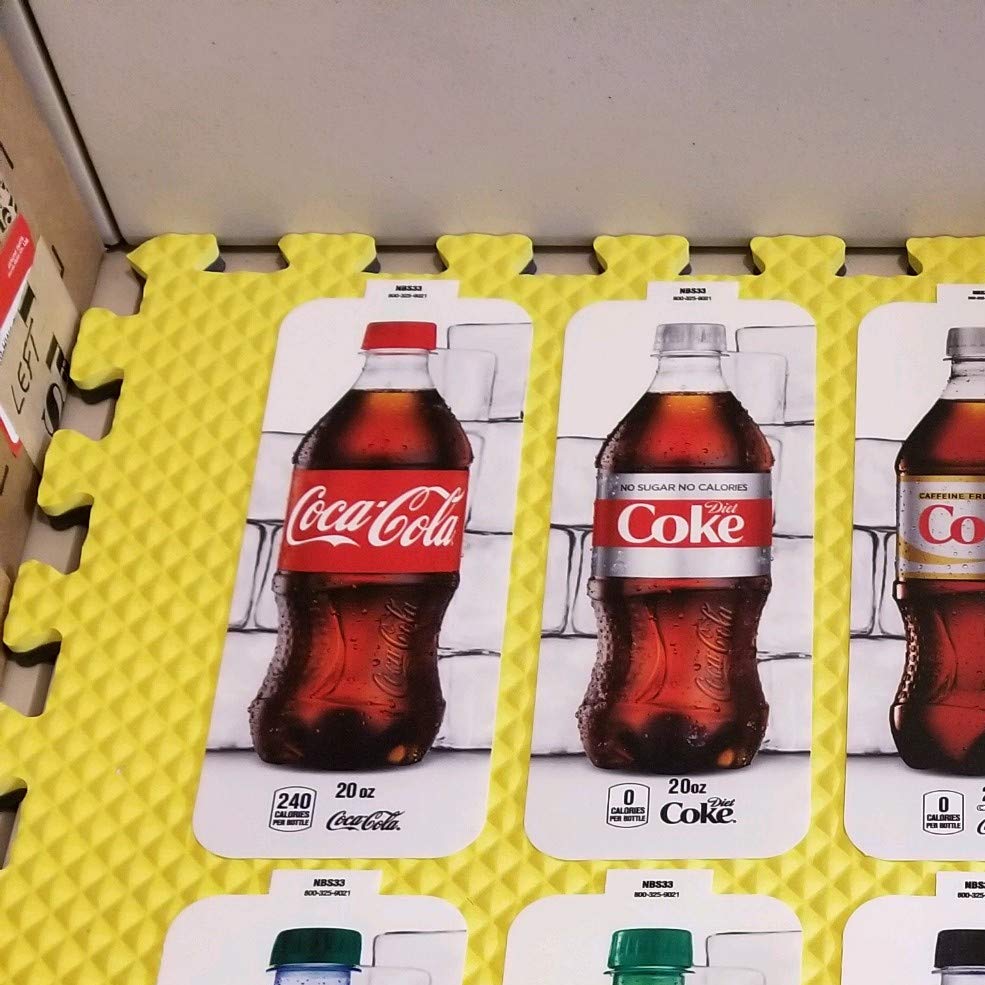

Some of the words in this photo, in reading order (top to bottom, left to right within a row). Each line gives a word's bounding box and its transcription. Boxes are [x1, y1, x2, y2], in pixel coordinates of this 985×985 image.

[620, 484, 635, 492] NO
[705, 501, 738, 514] Diet
[286, 485, 464, 547] Coca-Cola
[618, 503, 745, 544] Coke
[335, 782, 357, 798] 20
[359, 788, 375, 798] oz
[624, 789, 634, 805] 0
[277, 793, 312, 809] 240
[708, 797, 735, 807] Diet
[939, 797, 948, 812] 0
